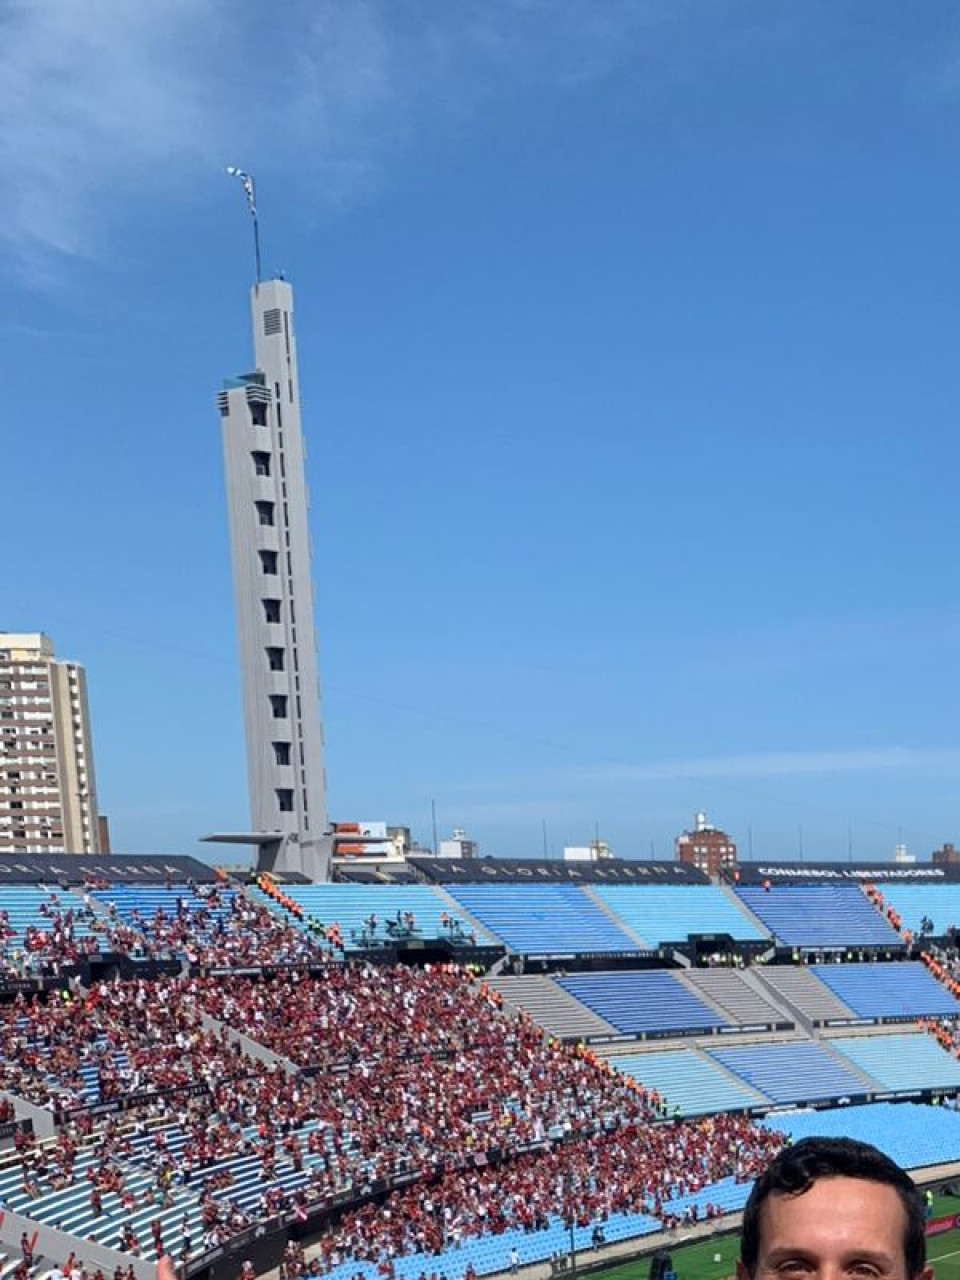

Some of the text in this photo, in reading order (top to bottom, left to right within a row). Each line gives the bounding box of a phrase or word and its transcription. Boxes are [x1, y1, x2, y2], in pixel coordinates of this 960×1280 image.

[480, 866, 581, 877] GLORIA
[757, 866, 945, 878] CONMEBOL LIBERTADORES
